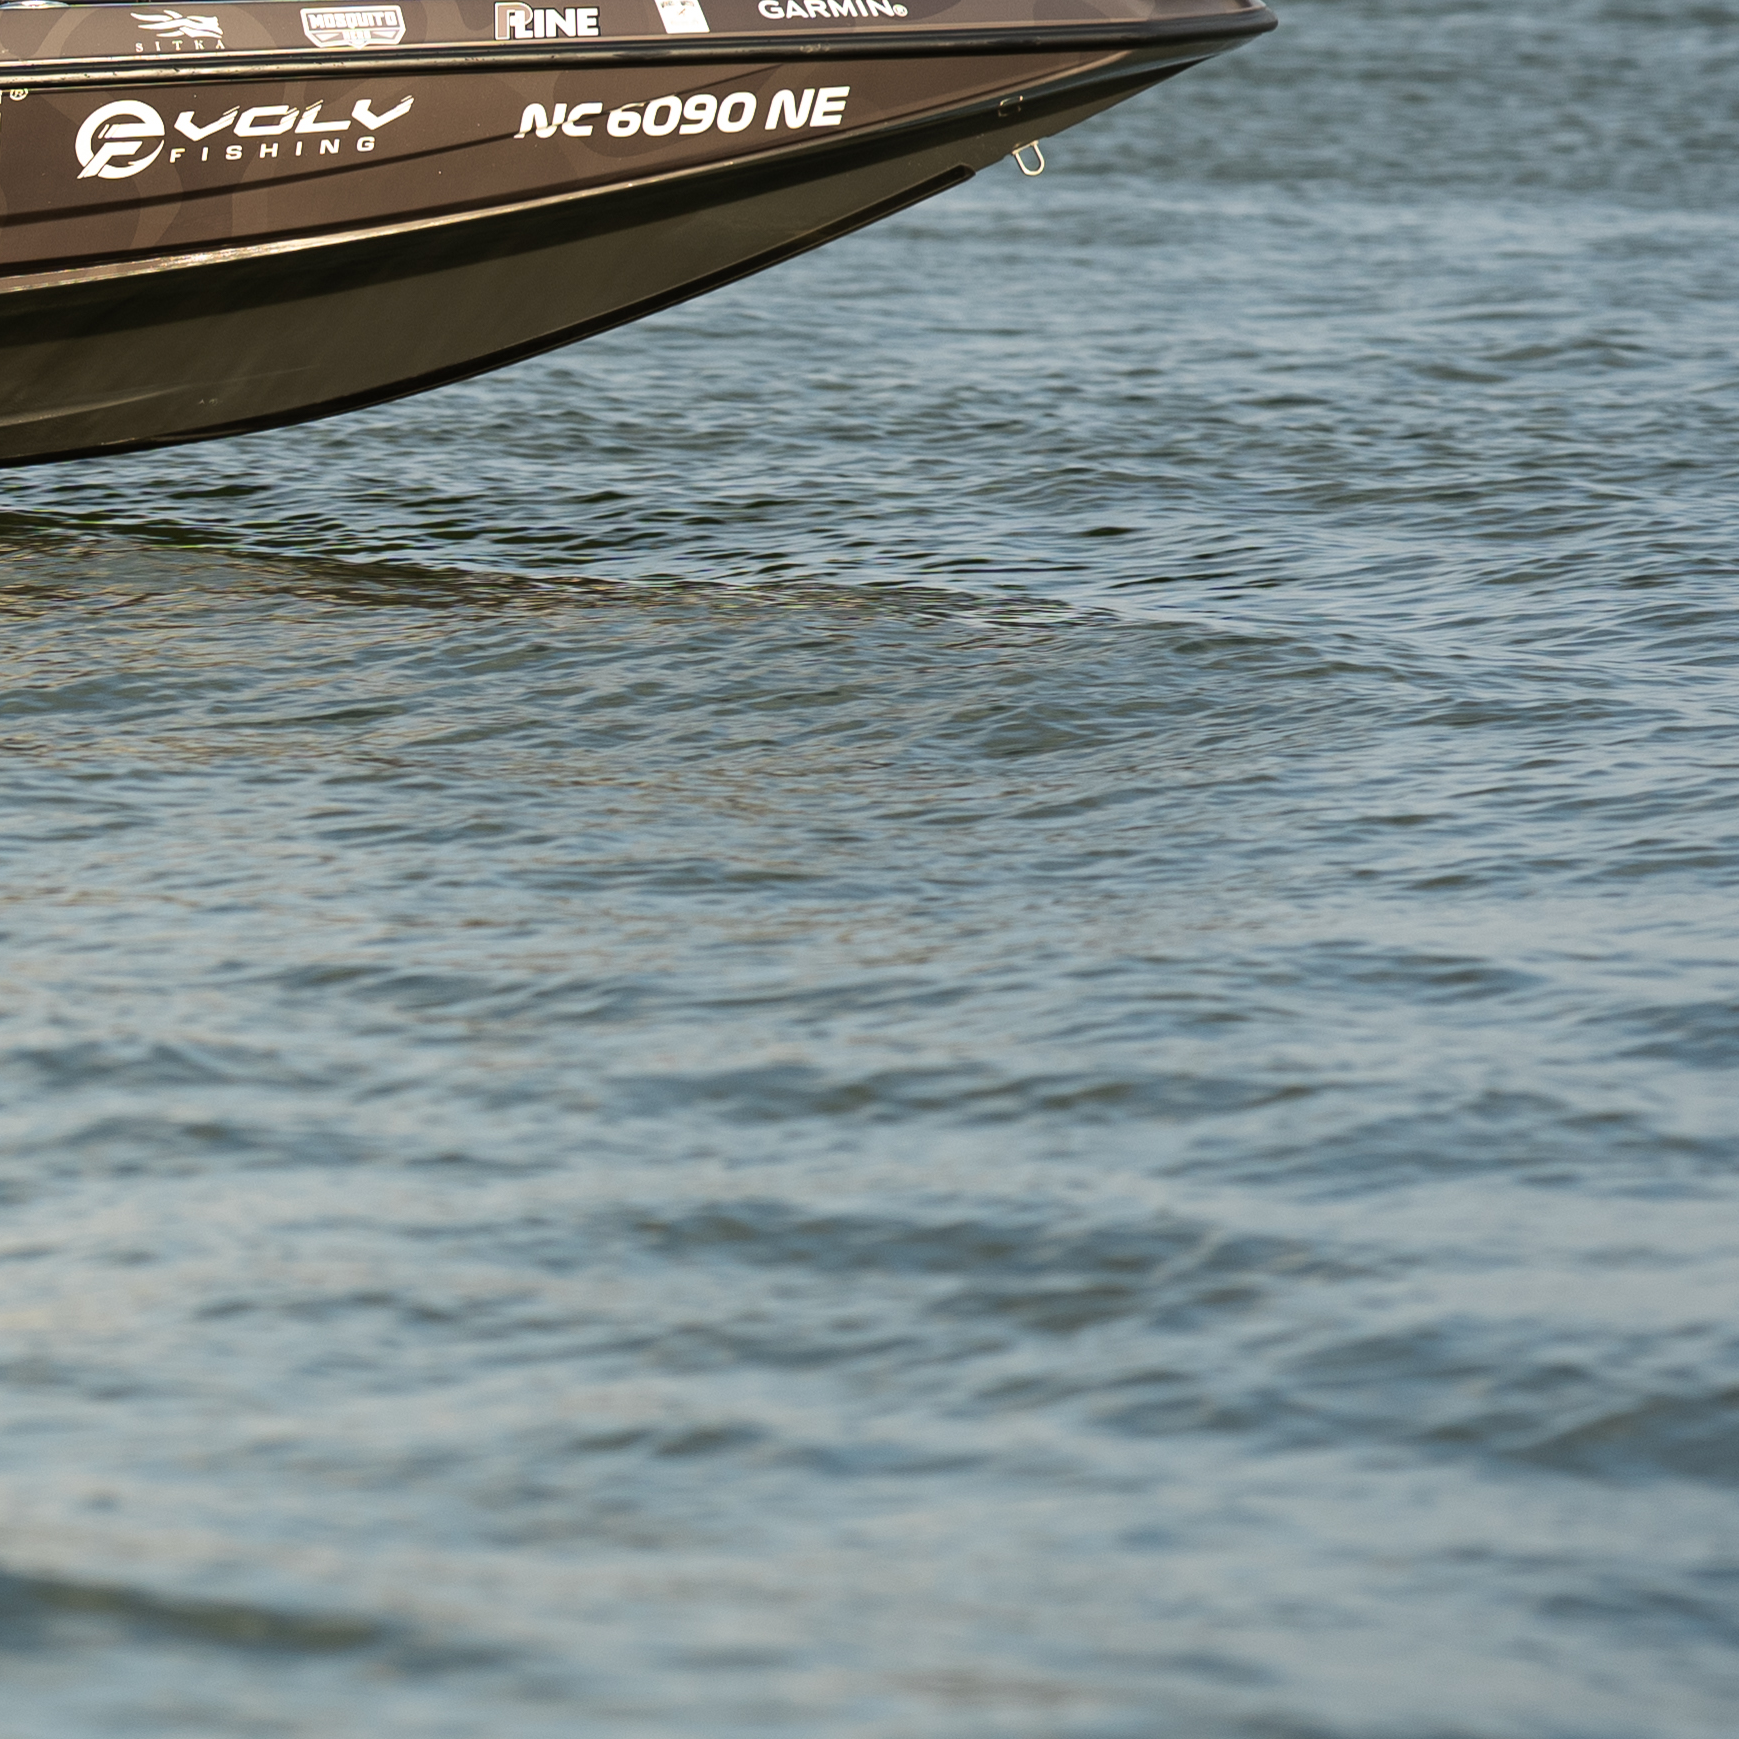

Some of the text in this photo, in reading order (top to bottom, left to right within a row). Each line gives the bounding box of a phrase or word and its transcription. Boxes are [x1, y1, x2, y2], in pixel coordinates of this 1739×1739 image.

[307, 11, 398, 29] MOSQUITO
[135, 39, 226, 53] SITKA
[513, 86, 851, 139] NC 6090 NE
[169, 136, 376, 163] FISHING
